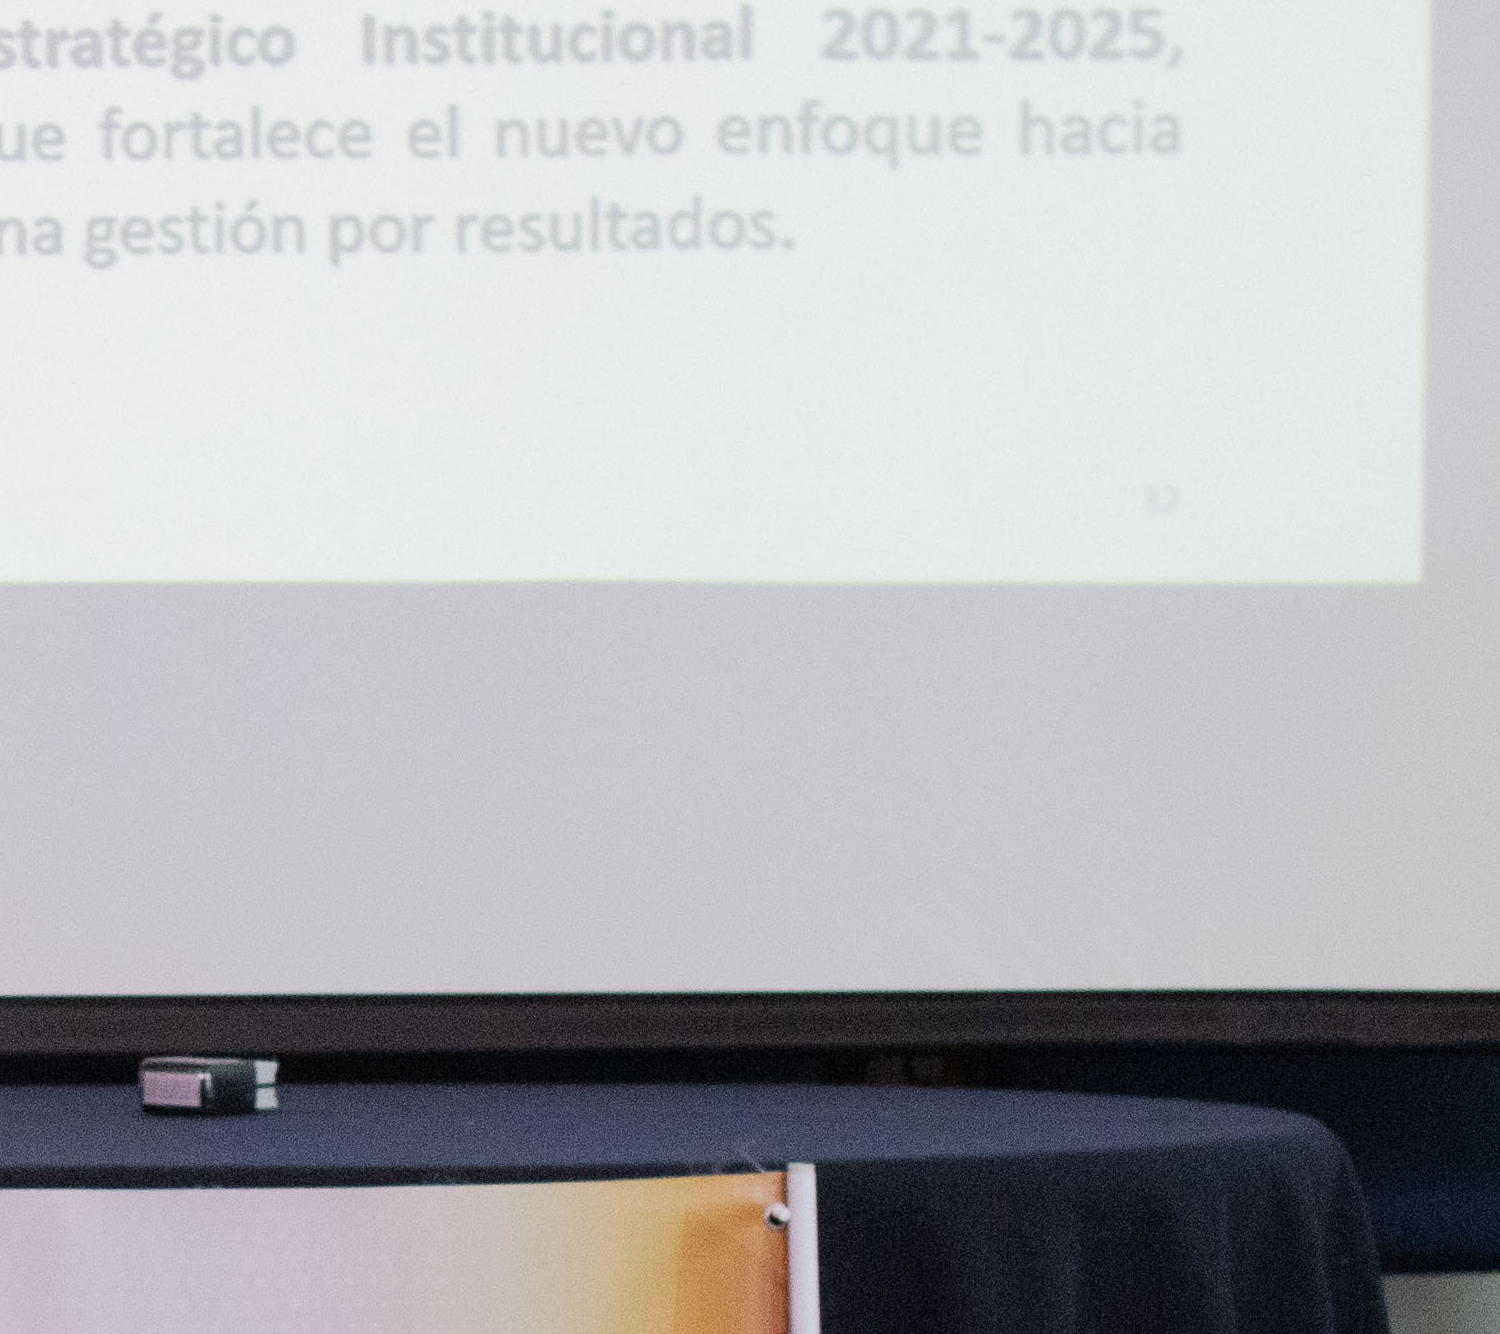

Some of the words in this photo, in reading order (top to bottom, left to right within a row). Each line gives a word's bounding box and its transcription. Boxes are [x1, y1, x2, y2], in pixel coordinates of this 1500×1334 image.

[361, 4, 754, 66] Institucional
[821, 7, 1184, 66] 2021-2025,
[98, 106, 374, 161] fortalece
[406, 103, 460, 160] el
[495, 114, 685, 158] nuevo
[716, 99, 983, 169] enfoque
[1019, 101, 1182, 155] hacia
[83, 201, 307, 271] gestión
[327, 212, 434, 267] por
[455, 198, 794, 254] resultados.
